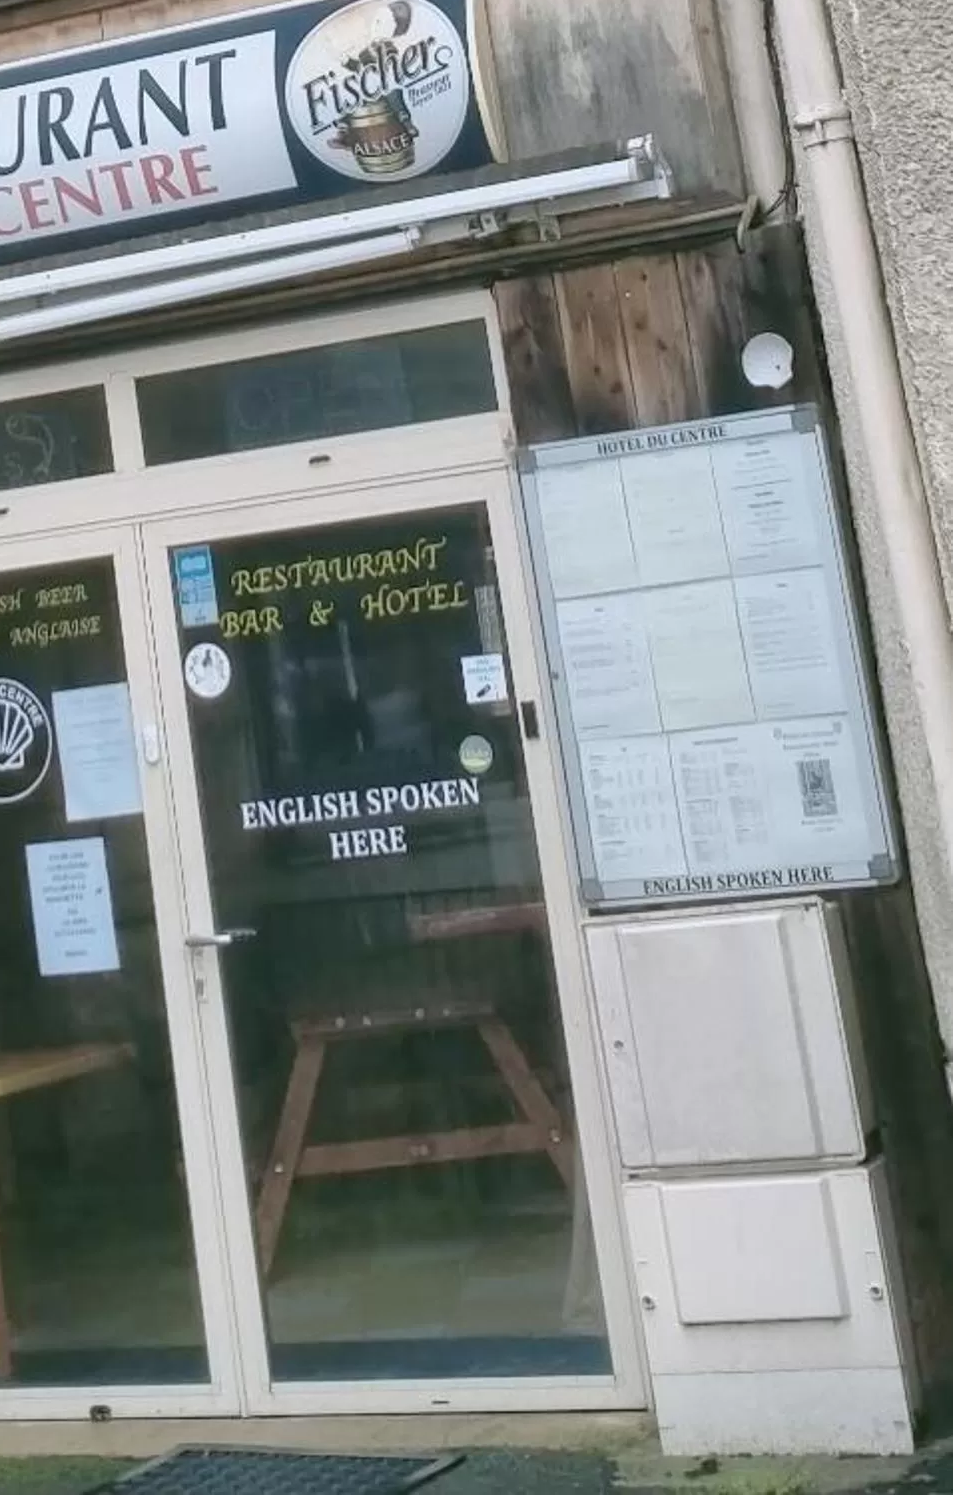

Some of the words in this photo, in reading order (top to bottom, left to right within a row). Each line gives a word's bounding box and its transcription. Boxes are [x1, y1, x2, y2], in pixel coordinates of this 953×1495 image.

[303, 36, 436, 129] Fischer
[353, 131, 408, 156] ALSACE
[596, 438, 644, 455] HOTEL
[647, 434, 667, 449] DU
[671, 425, 727, 445] CENTRE
[231, 537, 447, 596] RESTAURANT
[35, 584, 88, 608] BEER
[219, 607, 283, 637] BAR
[309, 601, 334, 626] &
[360, 581, 468, 620] HOTEL
[10, 616, 101, 648] ANGLAISE
[241, 791, 360, 830] ENGLISH
[365, 777, 480, 817] SPOKEN
[329, 826, 408, 860] HERE
[643, 875, 714, 895] ENGLISH
[716, 870, 784, 890] SPOKEN
[787, 866, 834, 883] HERE
